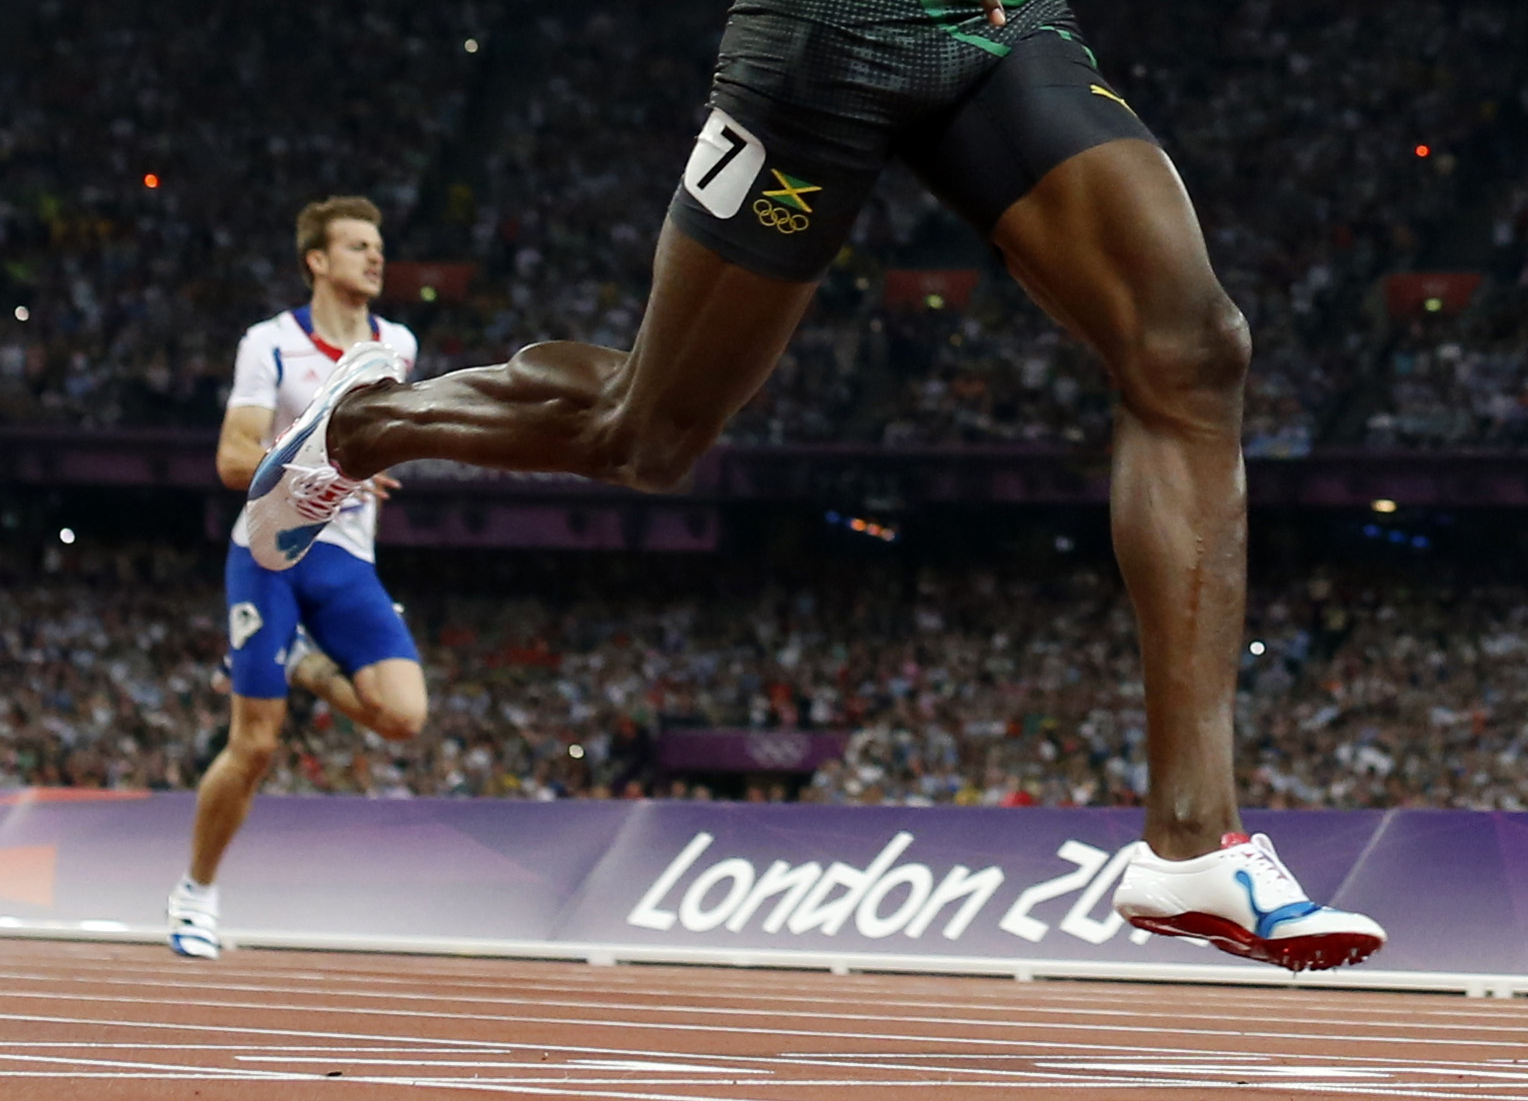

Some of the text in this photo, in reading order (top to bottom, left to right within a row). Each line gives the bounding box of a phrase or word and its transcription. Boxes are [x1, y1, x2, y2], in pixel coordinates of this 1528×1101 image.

[697, 125, 747, 190] 7
[627, 831, 1208, 947] London 20
